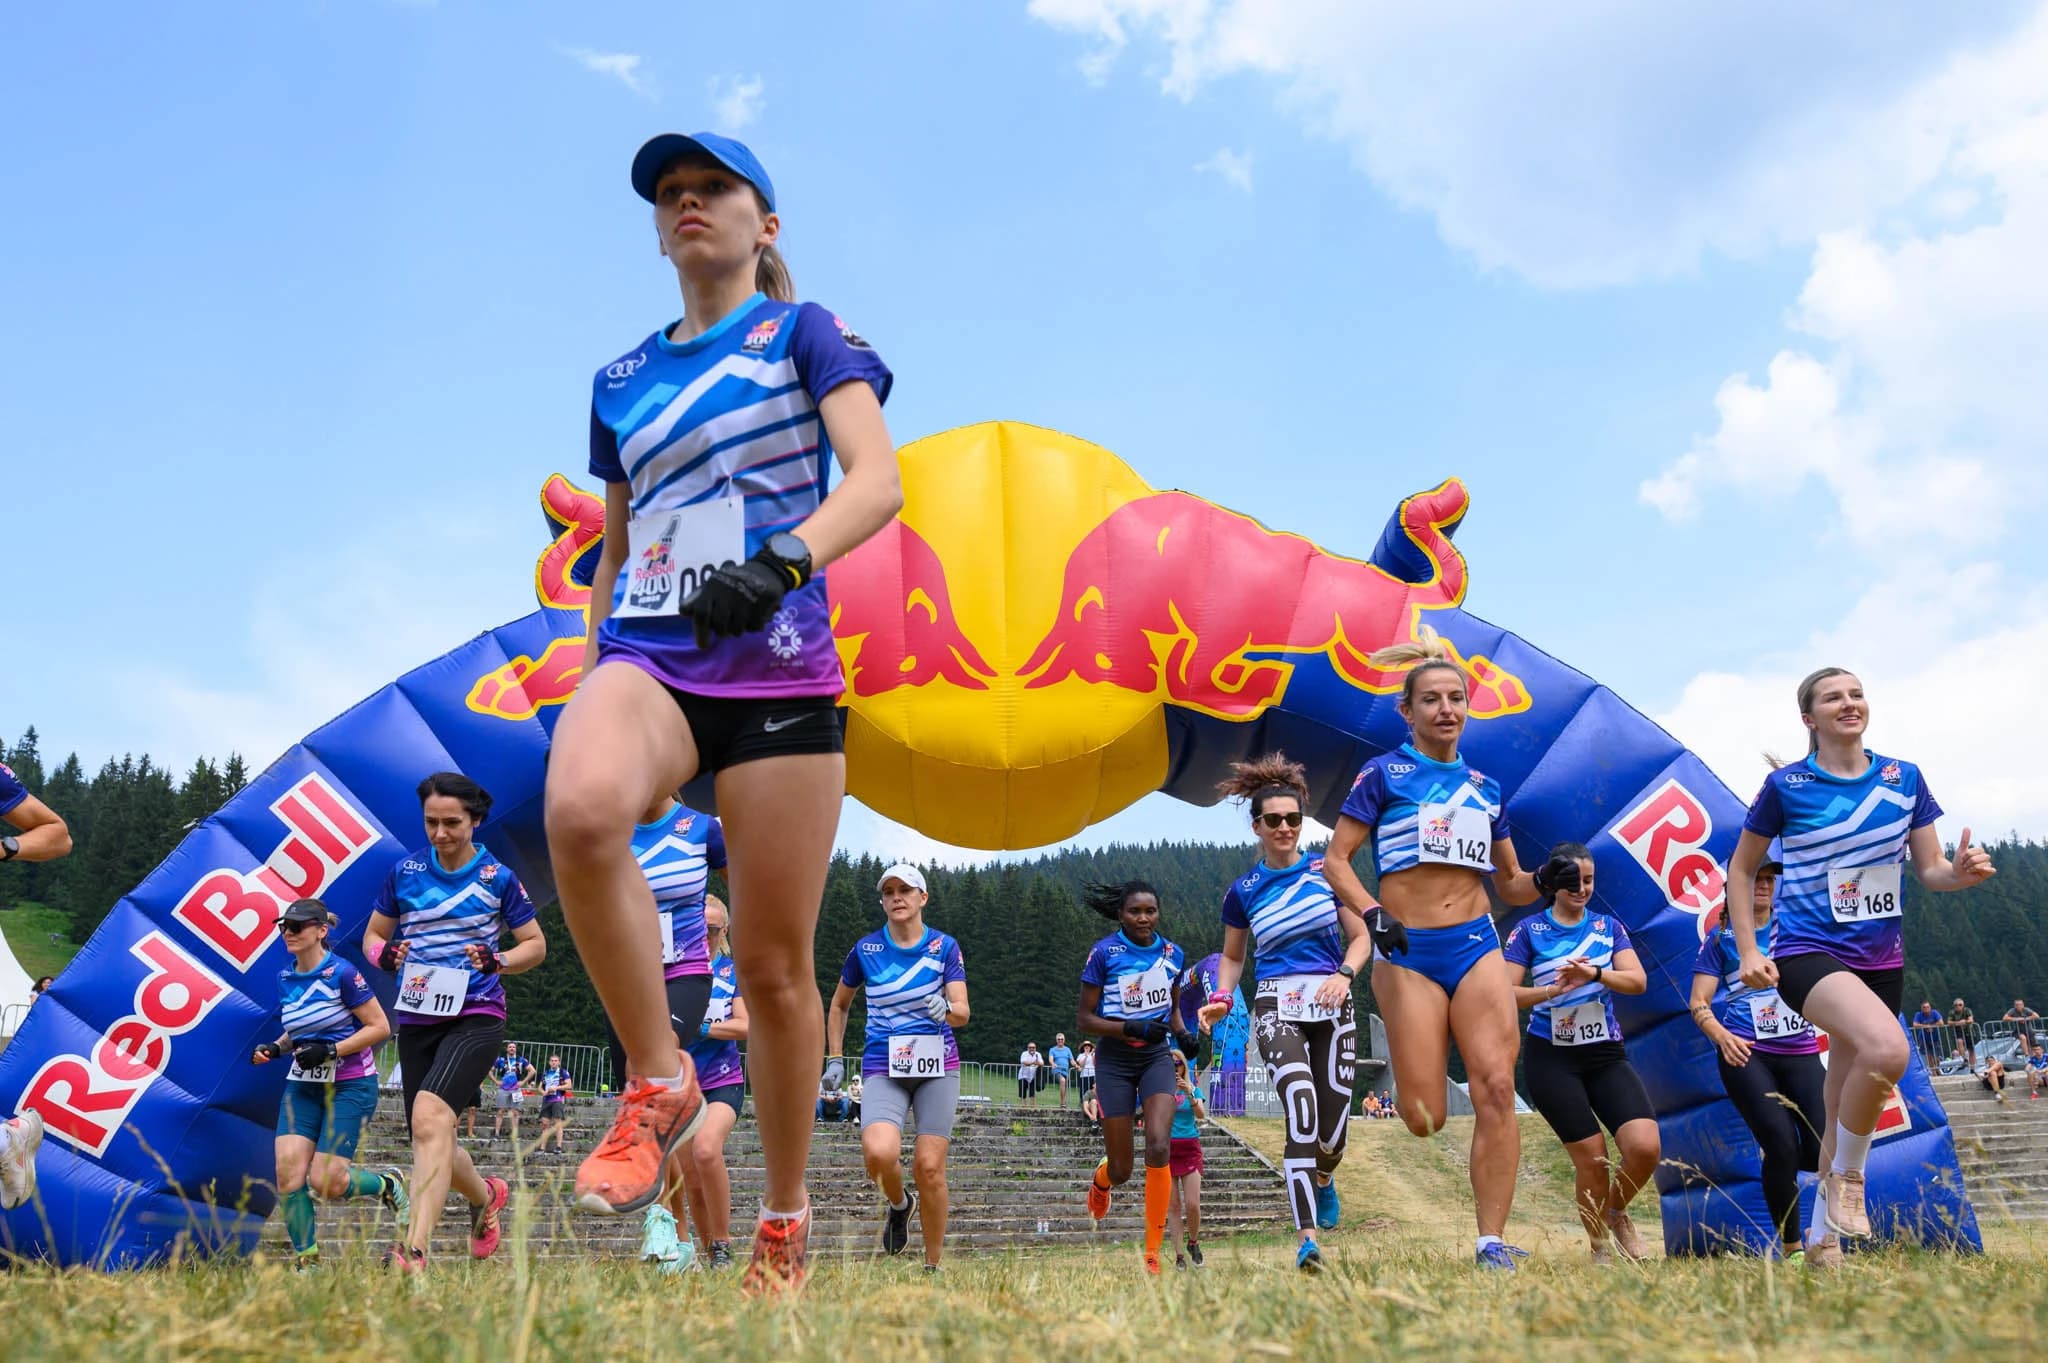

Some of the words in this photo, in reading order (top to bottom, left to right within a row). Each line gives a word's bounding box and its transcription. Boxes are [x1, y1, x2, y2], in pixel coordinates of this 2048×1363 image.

[1456, 838, 1486, 864] 142
[1864, 892, 1895, 915] 168
[20, 932, 227, 1151] Red
[177, 773, 374, 966] Bull
[434, 993, 455, 1013] 111
[1146, 987, 1168, 1006] 102
[1579, 1022, 1605, 1041] 132
[1782, 1014, 1807, 1032] 162
[310, 1065, 330, 1080] 137
[917, 1057, 940, 1074] 091
